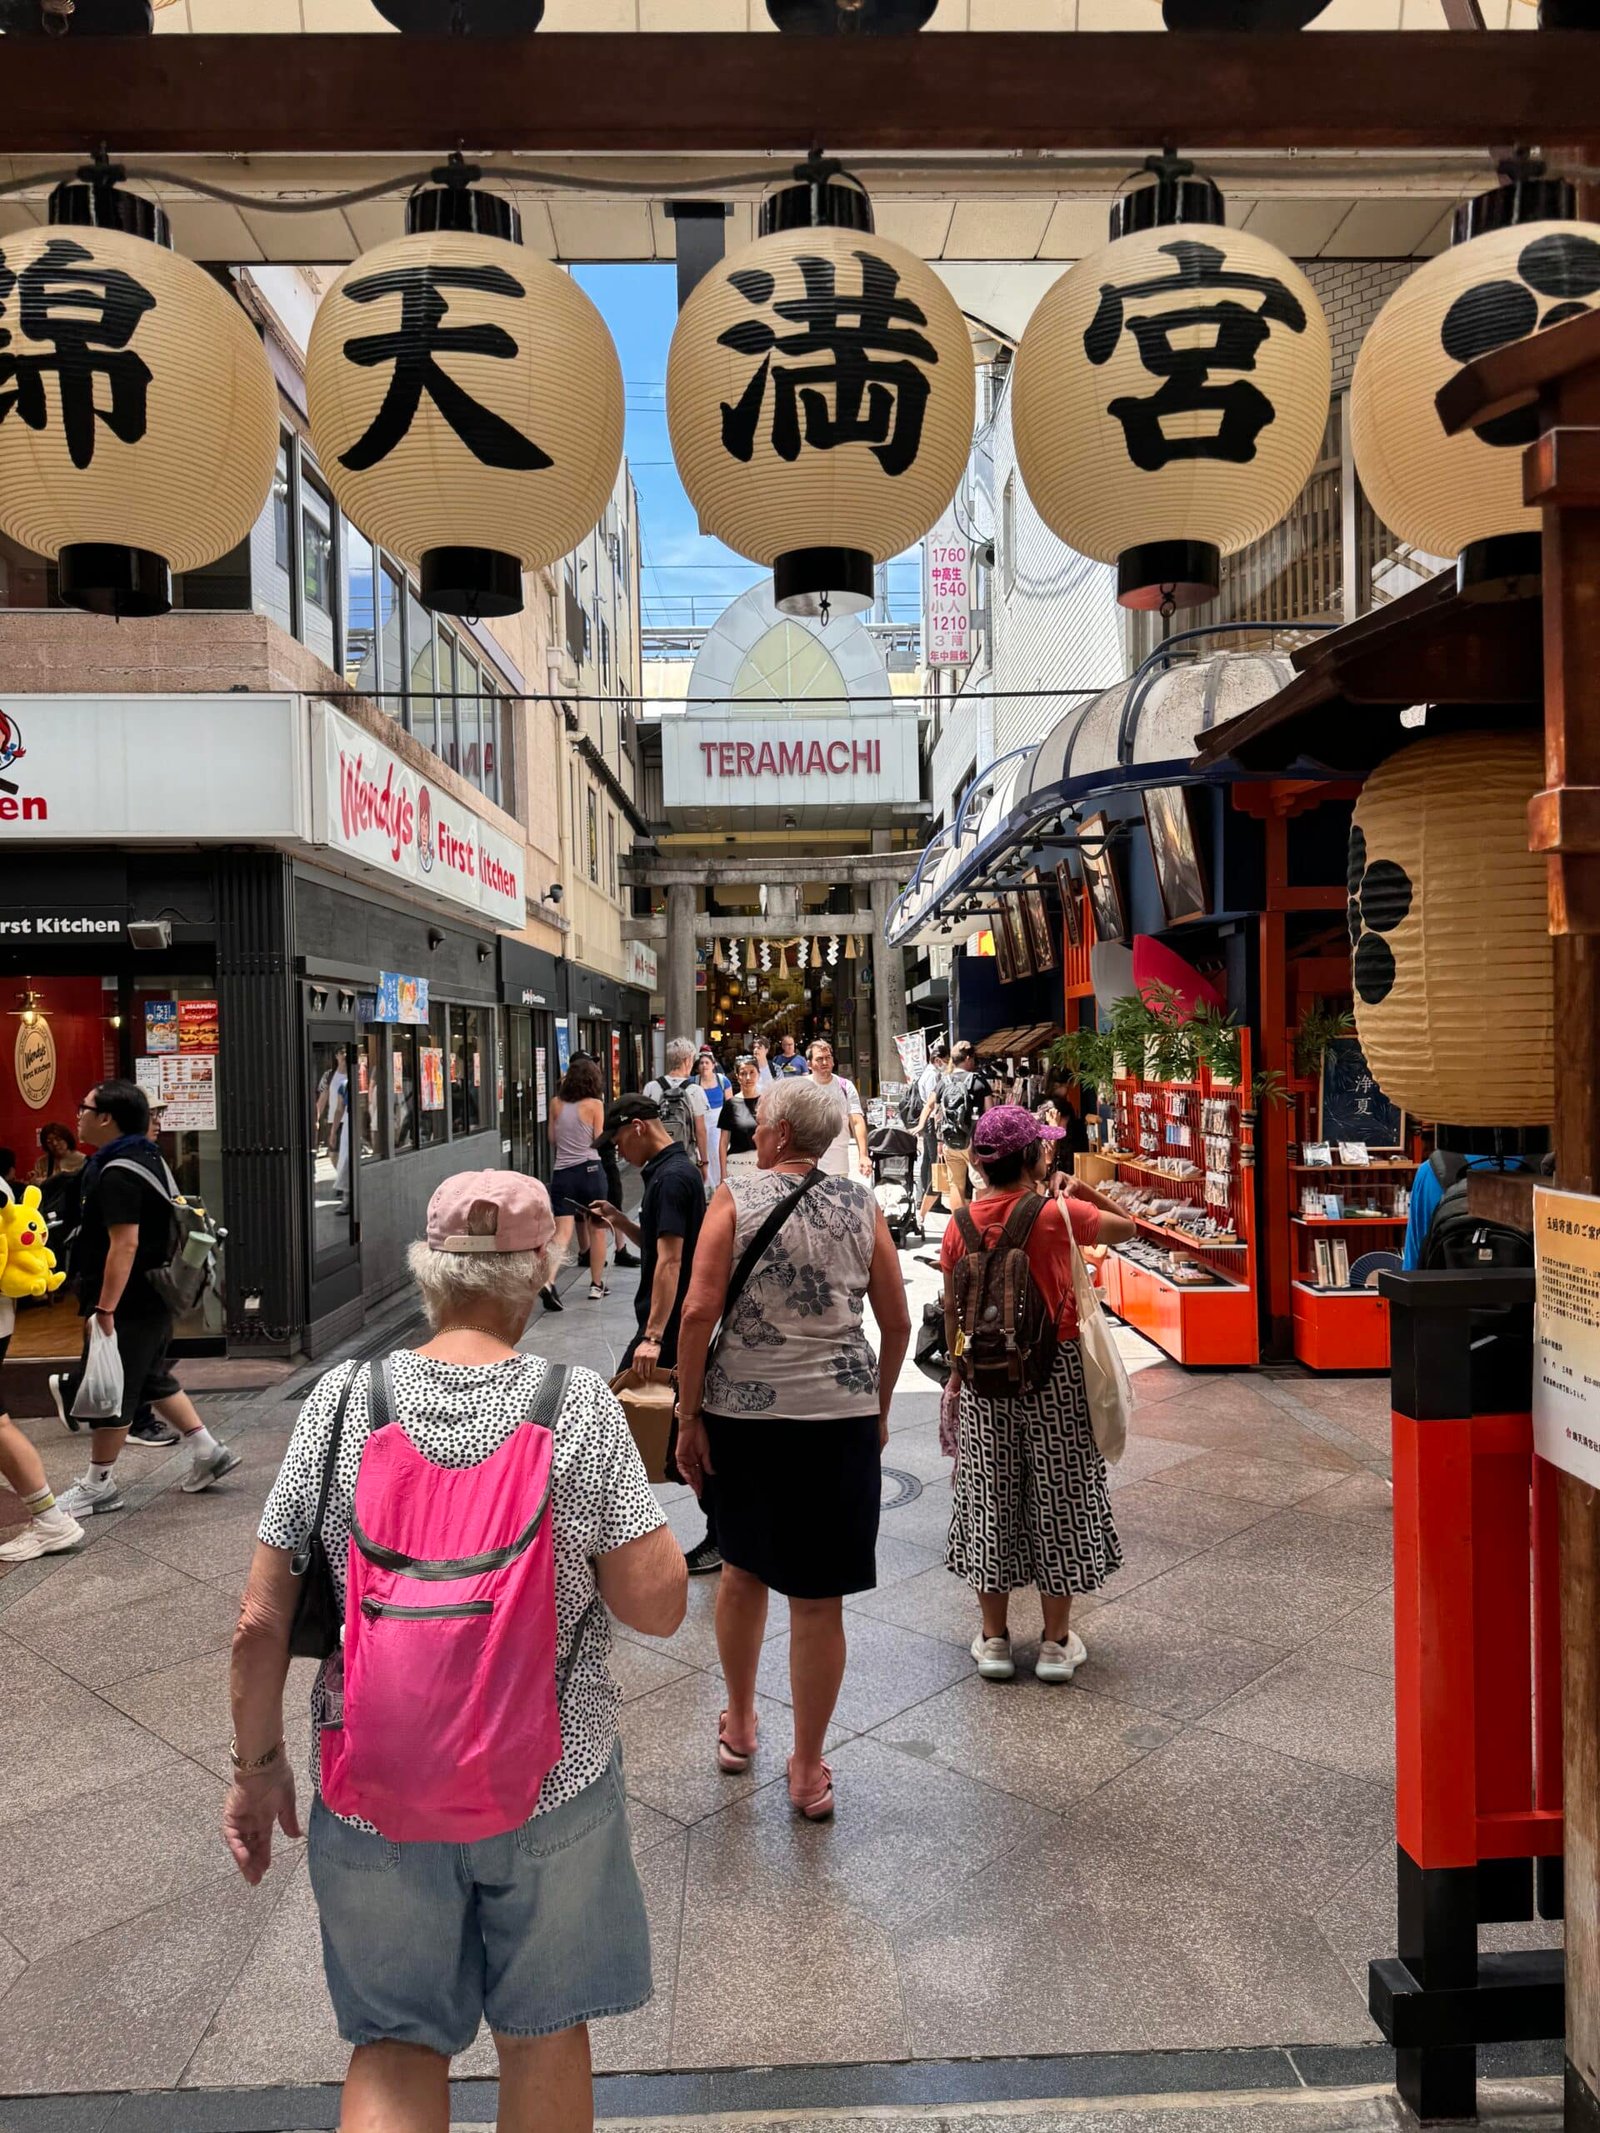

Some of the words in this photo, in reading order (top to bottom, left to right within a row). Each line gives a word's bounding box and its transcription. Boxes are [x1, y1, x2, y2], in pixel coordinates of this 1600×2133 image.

[716, 249, 939, 477] 満
[1083, 239, 1307, 472] 宮
[337, 264, 556, 471] 天
[930, 531, 960, 545] 大人
[932, 547, 966, 563] 1760
[931, 567, 962, 582] 中高生
[932, 582, 967, 598] 1540
[931, 601, 961, 614] 小人
[932, 616, 967, 631] 1210
[930, 650, 969, 663] 年中無休
[699, 739, 881, 778] TERAMACHI
[340, 750, 414, 863] Wendy's
[438, 820, 475, 878] First
[478, 845, 517, 900] Kitchen
[36, 917, 120, 934] Kitchen
[1354, 1074, 1374, 1115] 浄夏
